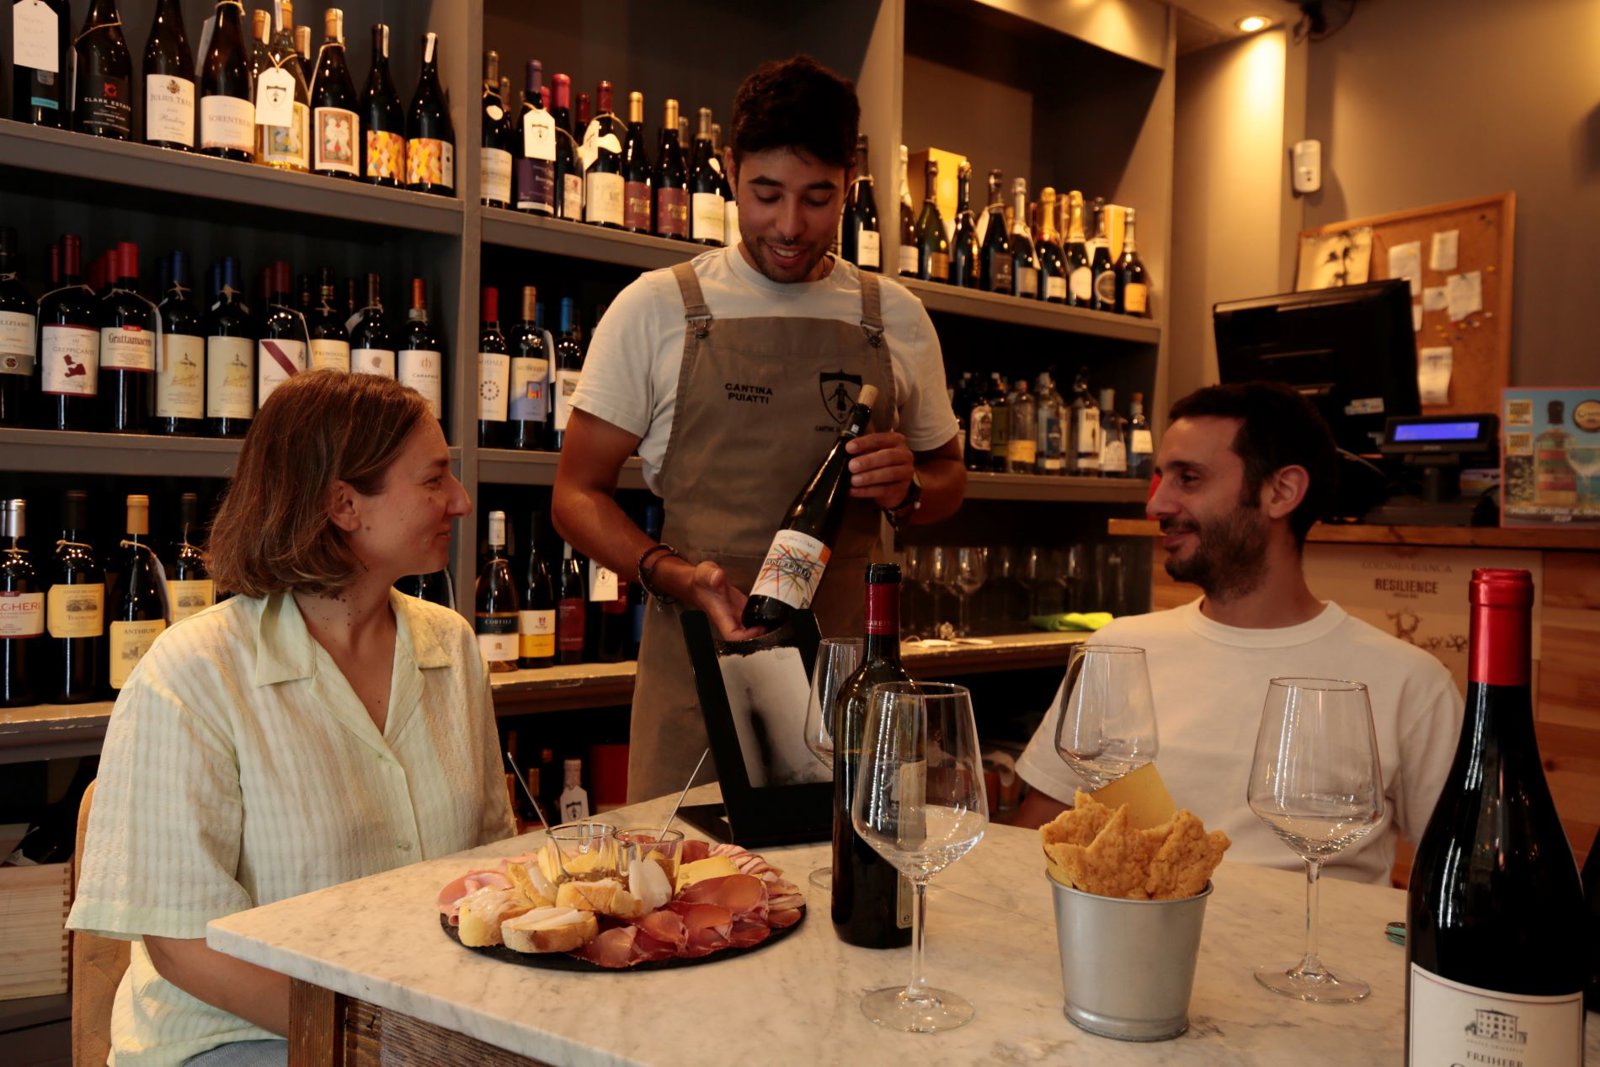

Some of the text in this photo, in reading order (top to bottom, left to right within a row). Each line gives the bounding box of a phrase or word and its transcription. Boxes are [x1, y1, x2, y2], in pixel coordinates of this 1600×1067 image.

[83, 96, 108, 105] CLARK
[725, 383, 773, 396] CANTINA
[728, 392, 770, 405] PUIATTI
[1374, 578, 1440, 595] RESILIENCE
